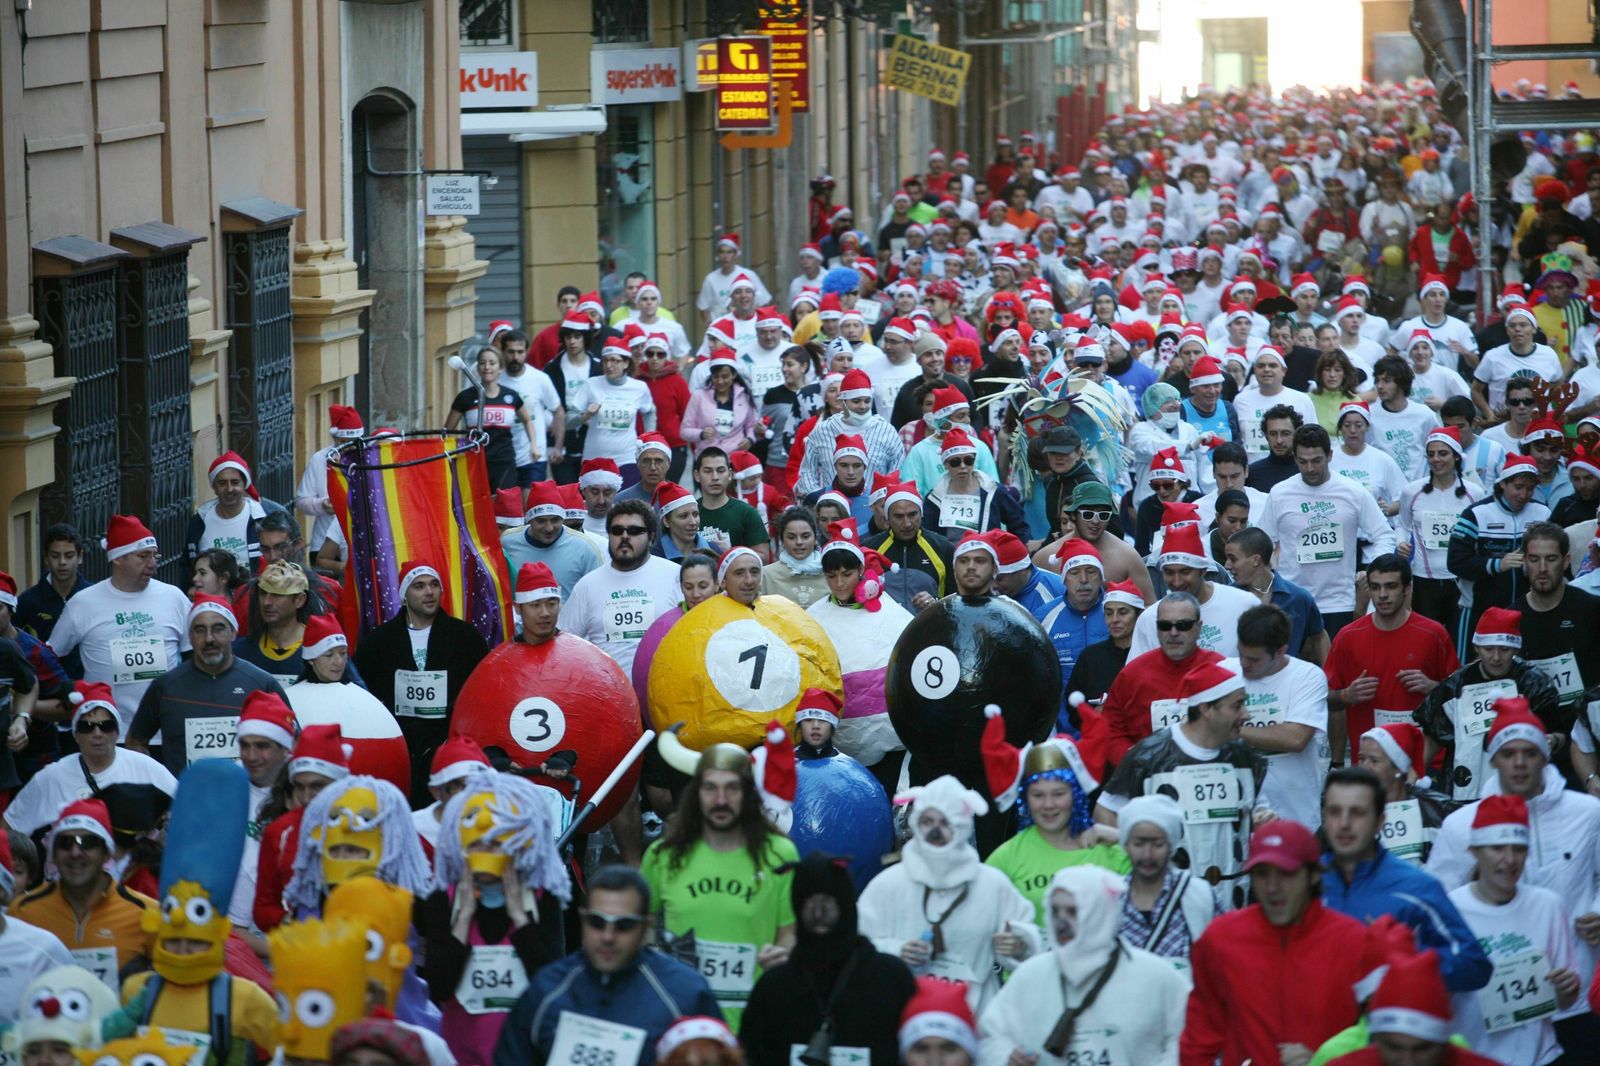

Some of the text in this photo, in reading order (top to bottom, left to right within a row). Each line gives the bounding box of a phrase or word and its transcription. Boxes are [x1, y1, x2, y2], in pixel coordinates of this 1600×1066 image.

[898, 39, 964, 70] ALQUILA
[895, 57, 958, 88] BERNA
[721, 90, 768, 103] ESTANCO
[719, 107, 770, 120] CATEDRAL
[445, 179, 460, 187] LUZ
[485, 411, 503, 423] DB
[603, 408, 630, 420] 1138
[950, 506, 974, 518] 713
[1302, 531, 1337, 546] 2063
[614, 611, 643, 626] 995
[124, 651, 155, 667] 603
[738, 643, 768, 690] 1
[924, 656, 944, 689] 8
[406, 686, 435, 701] 896
[523, 708, 551, 742] 3
[193, 732, 237, 749] 2297
[1194, 782, 1227, 801] 873
[472, 969, 514, 989] 634
[1496, 974, 1539, 1003] 134
